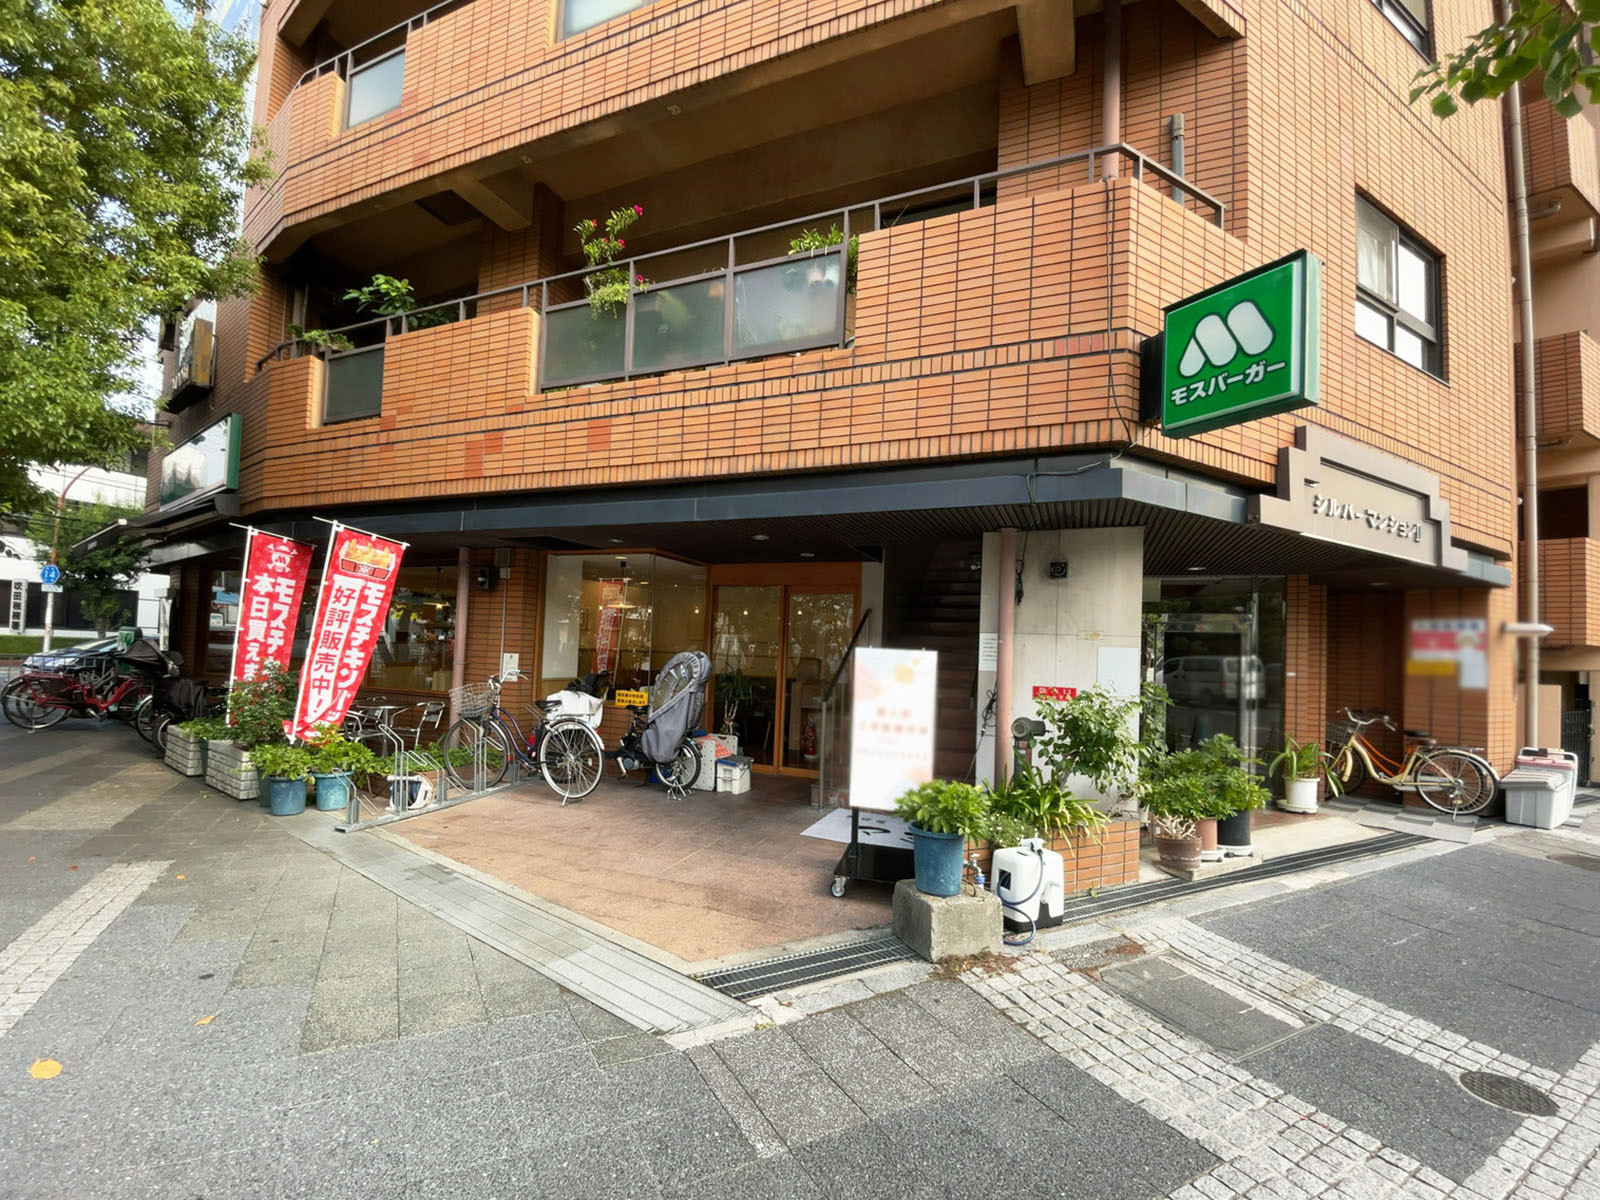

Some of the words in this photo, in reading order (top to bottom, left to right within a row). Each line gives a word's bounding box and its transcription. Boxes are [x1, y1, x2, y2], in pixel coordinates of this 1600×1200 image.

[1170, 360, 1286, 405] モスバーガー
[44, 571, 56, 579] 14
[318, 581, 386, 728] モスチキンパッ
